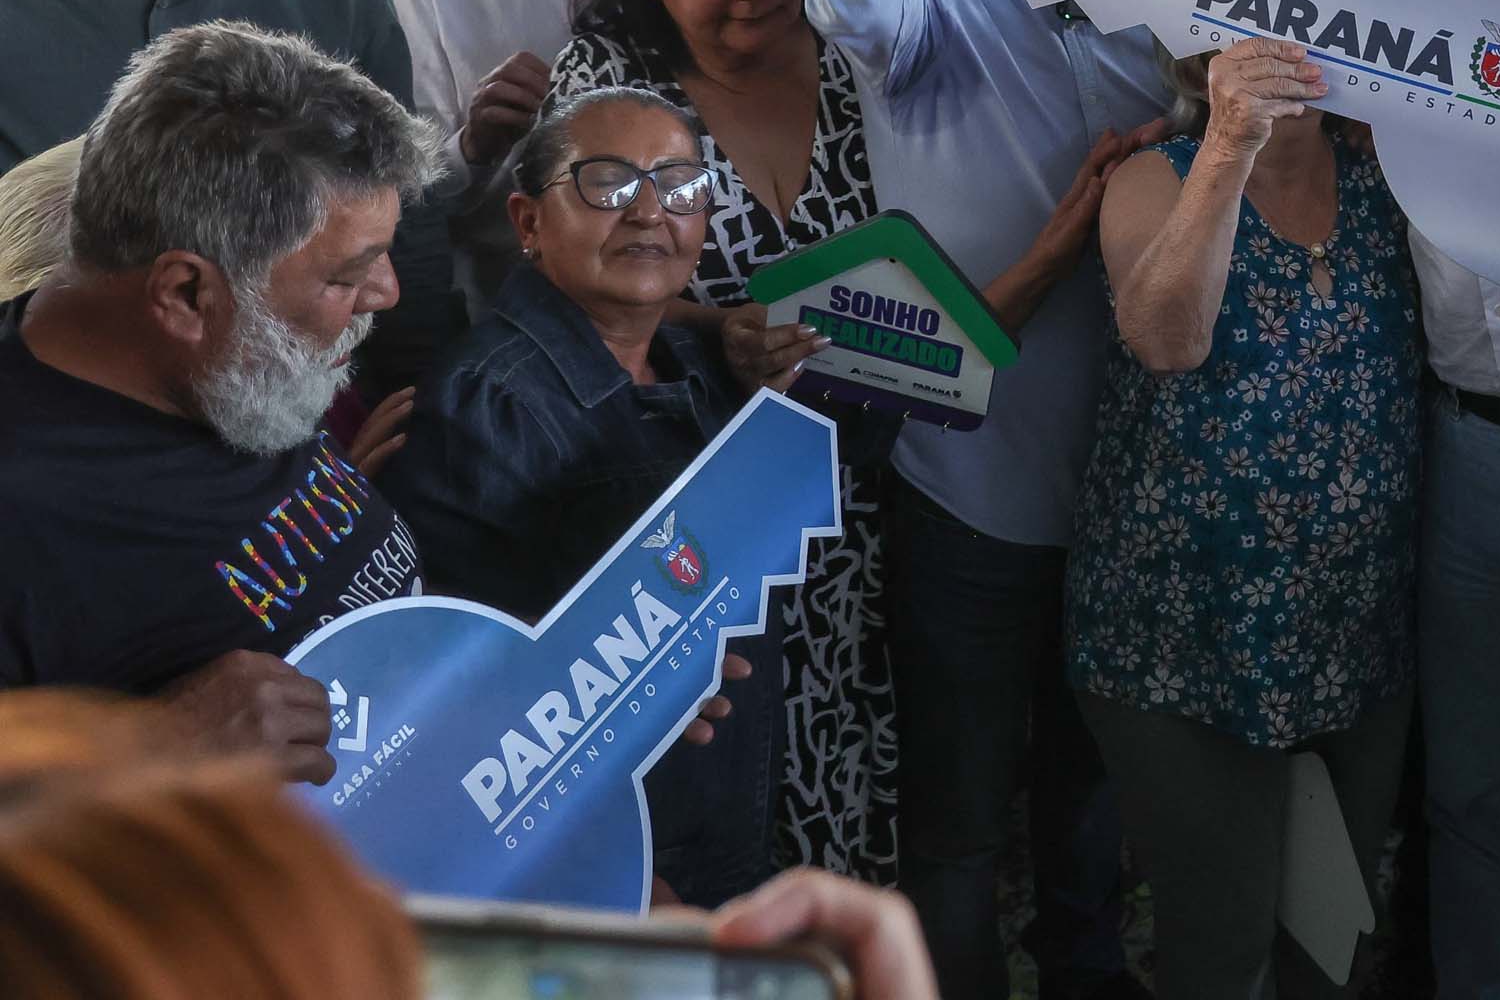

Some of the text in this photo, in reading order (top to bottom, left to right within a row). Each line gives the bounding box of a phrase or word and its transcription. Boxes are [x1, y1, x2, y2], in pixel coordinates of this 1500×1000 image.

[1347, 73, 1382, 93] DO
[829, 285, 940, 336] SONHO
[461, 579, 682, 823] PARANÁ
[504, 586, 741, 850] GOVERNO DO ESTADO
[333, 724, 416, 805] CASA FÁCIL
